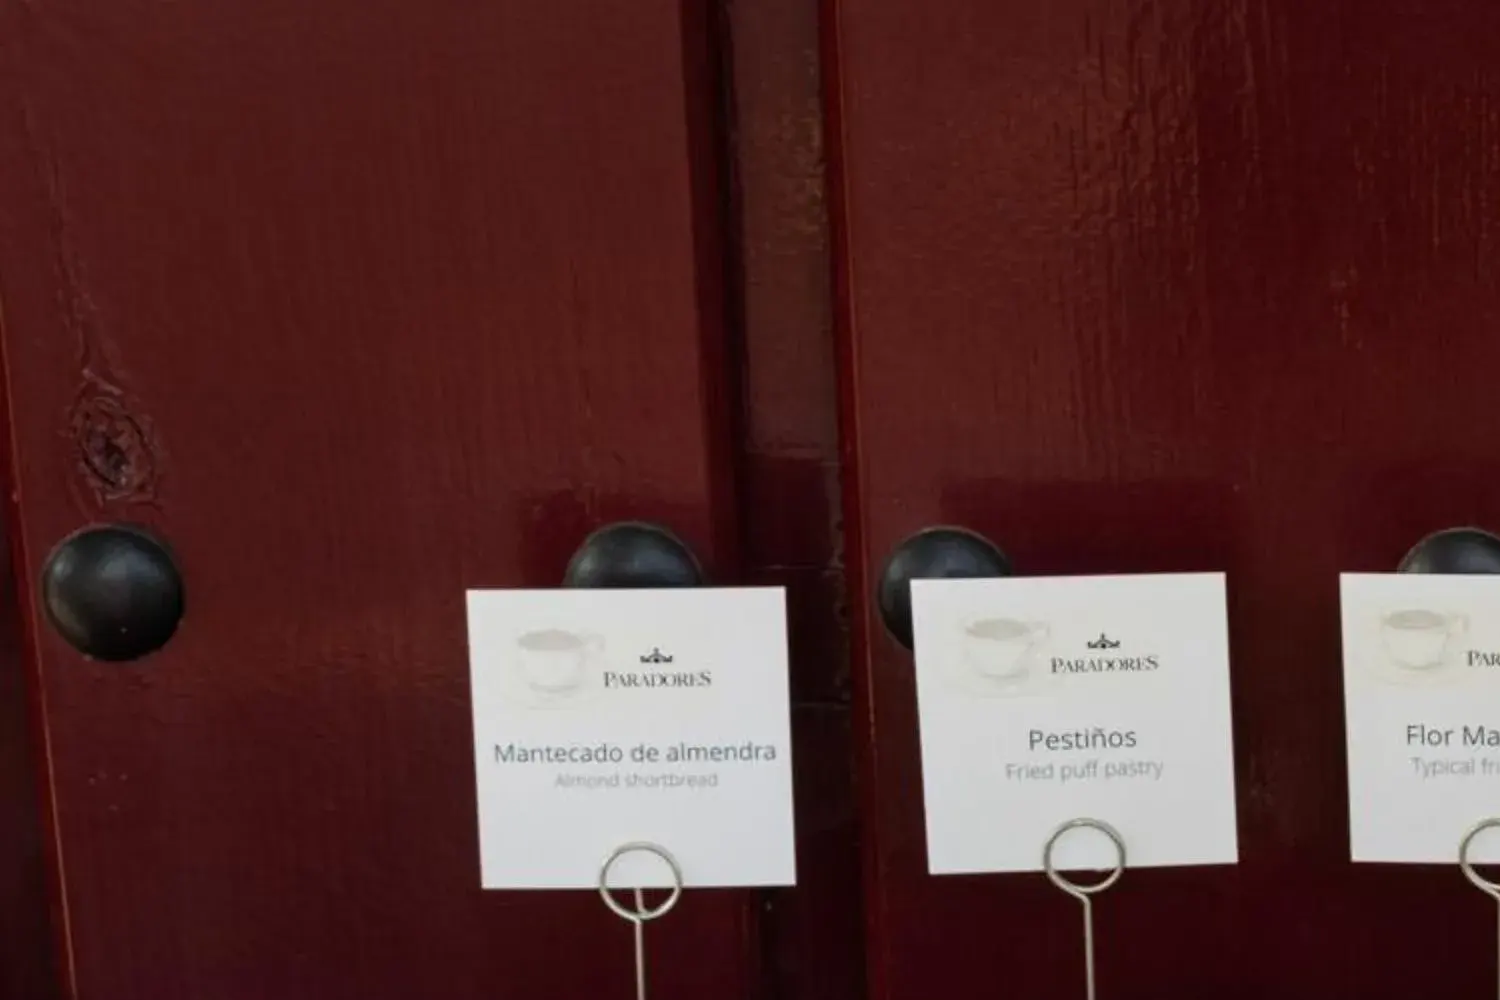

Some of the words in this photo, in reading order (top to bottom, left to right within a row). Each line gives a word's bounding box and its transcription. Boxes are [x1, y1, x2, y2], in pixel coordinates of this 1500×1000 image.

[1050, 656, 1159, 674] PARADORES
[603, 671, 712, 688] PARADORES
[1028, 727, 1138, 751] Pestiños
[1406, 724, 1454, 747] Flor
[494, 743, 623, 764] Mantecado
[630, 743, 659, 763] de
[666, 741, 777, 762] almendra
[1005, 762, 1054, 781] Fried
[1060, 760, 1098, 783] puff
[1104, 759, 1164, 781] pastry
[1411, 756, 1475, 780] Typical
[554, 772, 620, 789] Almond
[624, 771, 719, 788] shortbread
